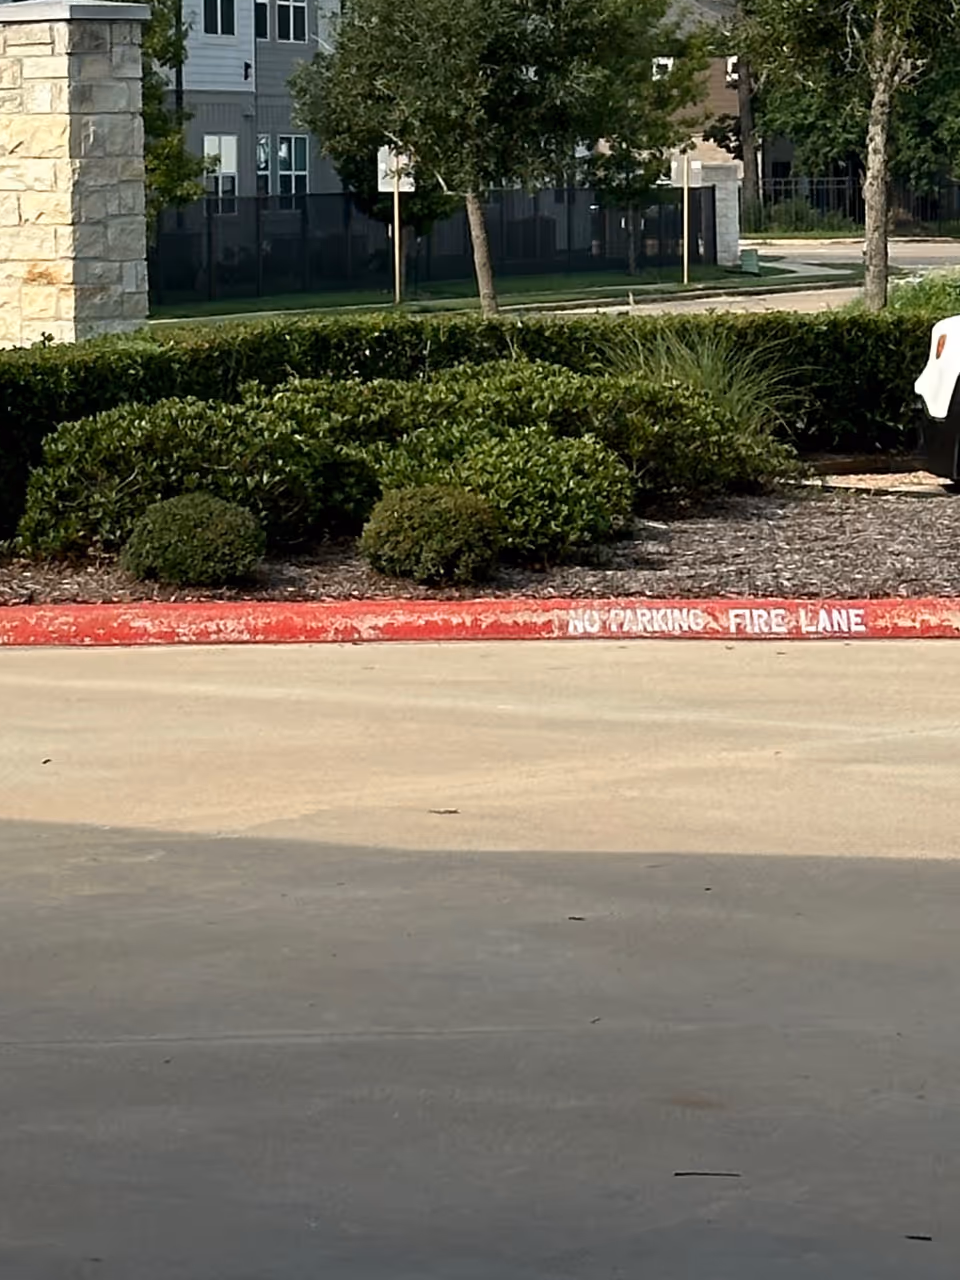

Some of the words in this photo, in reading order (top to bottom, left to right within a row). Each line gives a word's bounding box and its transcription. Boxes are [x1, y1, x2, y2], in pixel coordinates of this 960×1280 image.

[568, 609, 600, 633] NO
[610, 607, 705, 632] PARKING
[728, 608, 786, 632] FIRE
[800, 607, 866, 632] LANE
